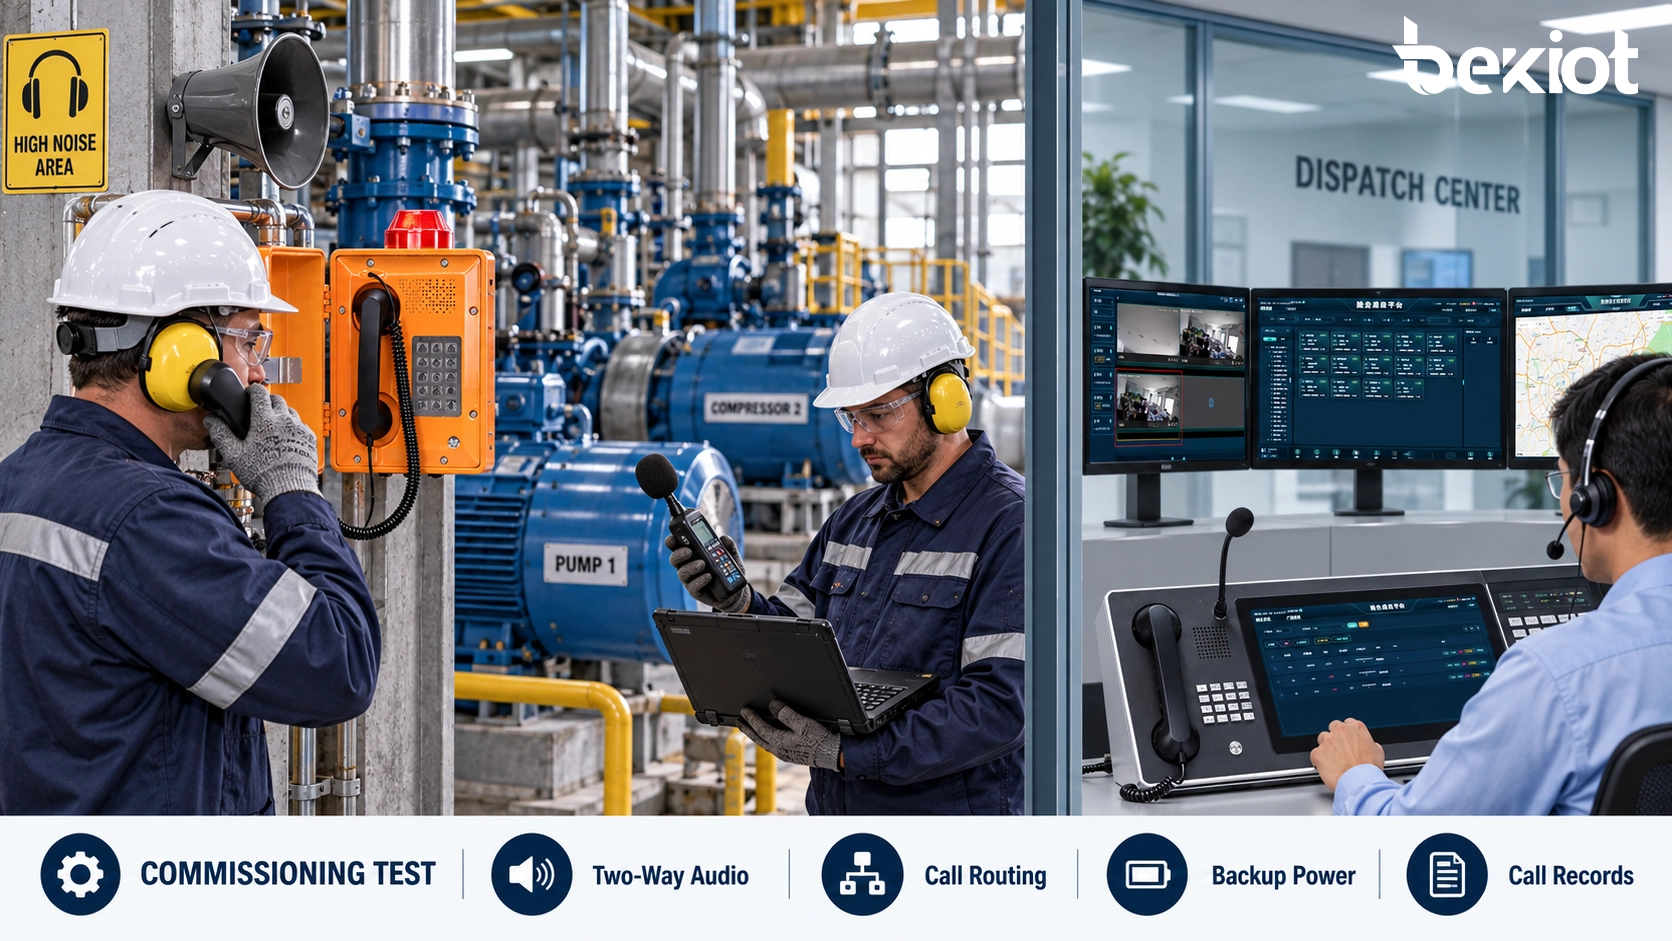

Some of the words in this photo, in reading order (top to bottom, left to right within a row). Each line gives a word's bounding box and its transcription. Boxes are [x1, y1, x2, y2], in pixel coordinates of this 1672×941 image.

[14, 134, 48, 154] HIGH
[53, 134, 97, 153] NOISE
[35, 158, 74, 177] AREA
[1296, 155, 1425, 202] DISPATCH
[1435, 176, 1521, 214] CENTER
[711, 401, 789, 416] COMPRESSOR
[793, 402, 801, 415] 2
[555, 555, 602, 573] PUMP
[609, 557, 616, 573] 1
